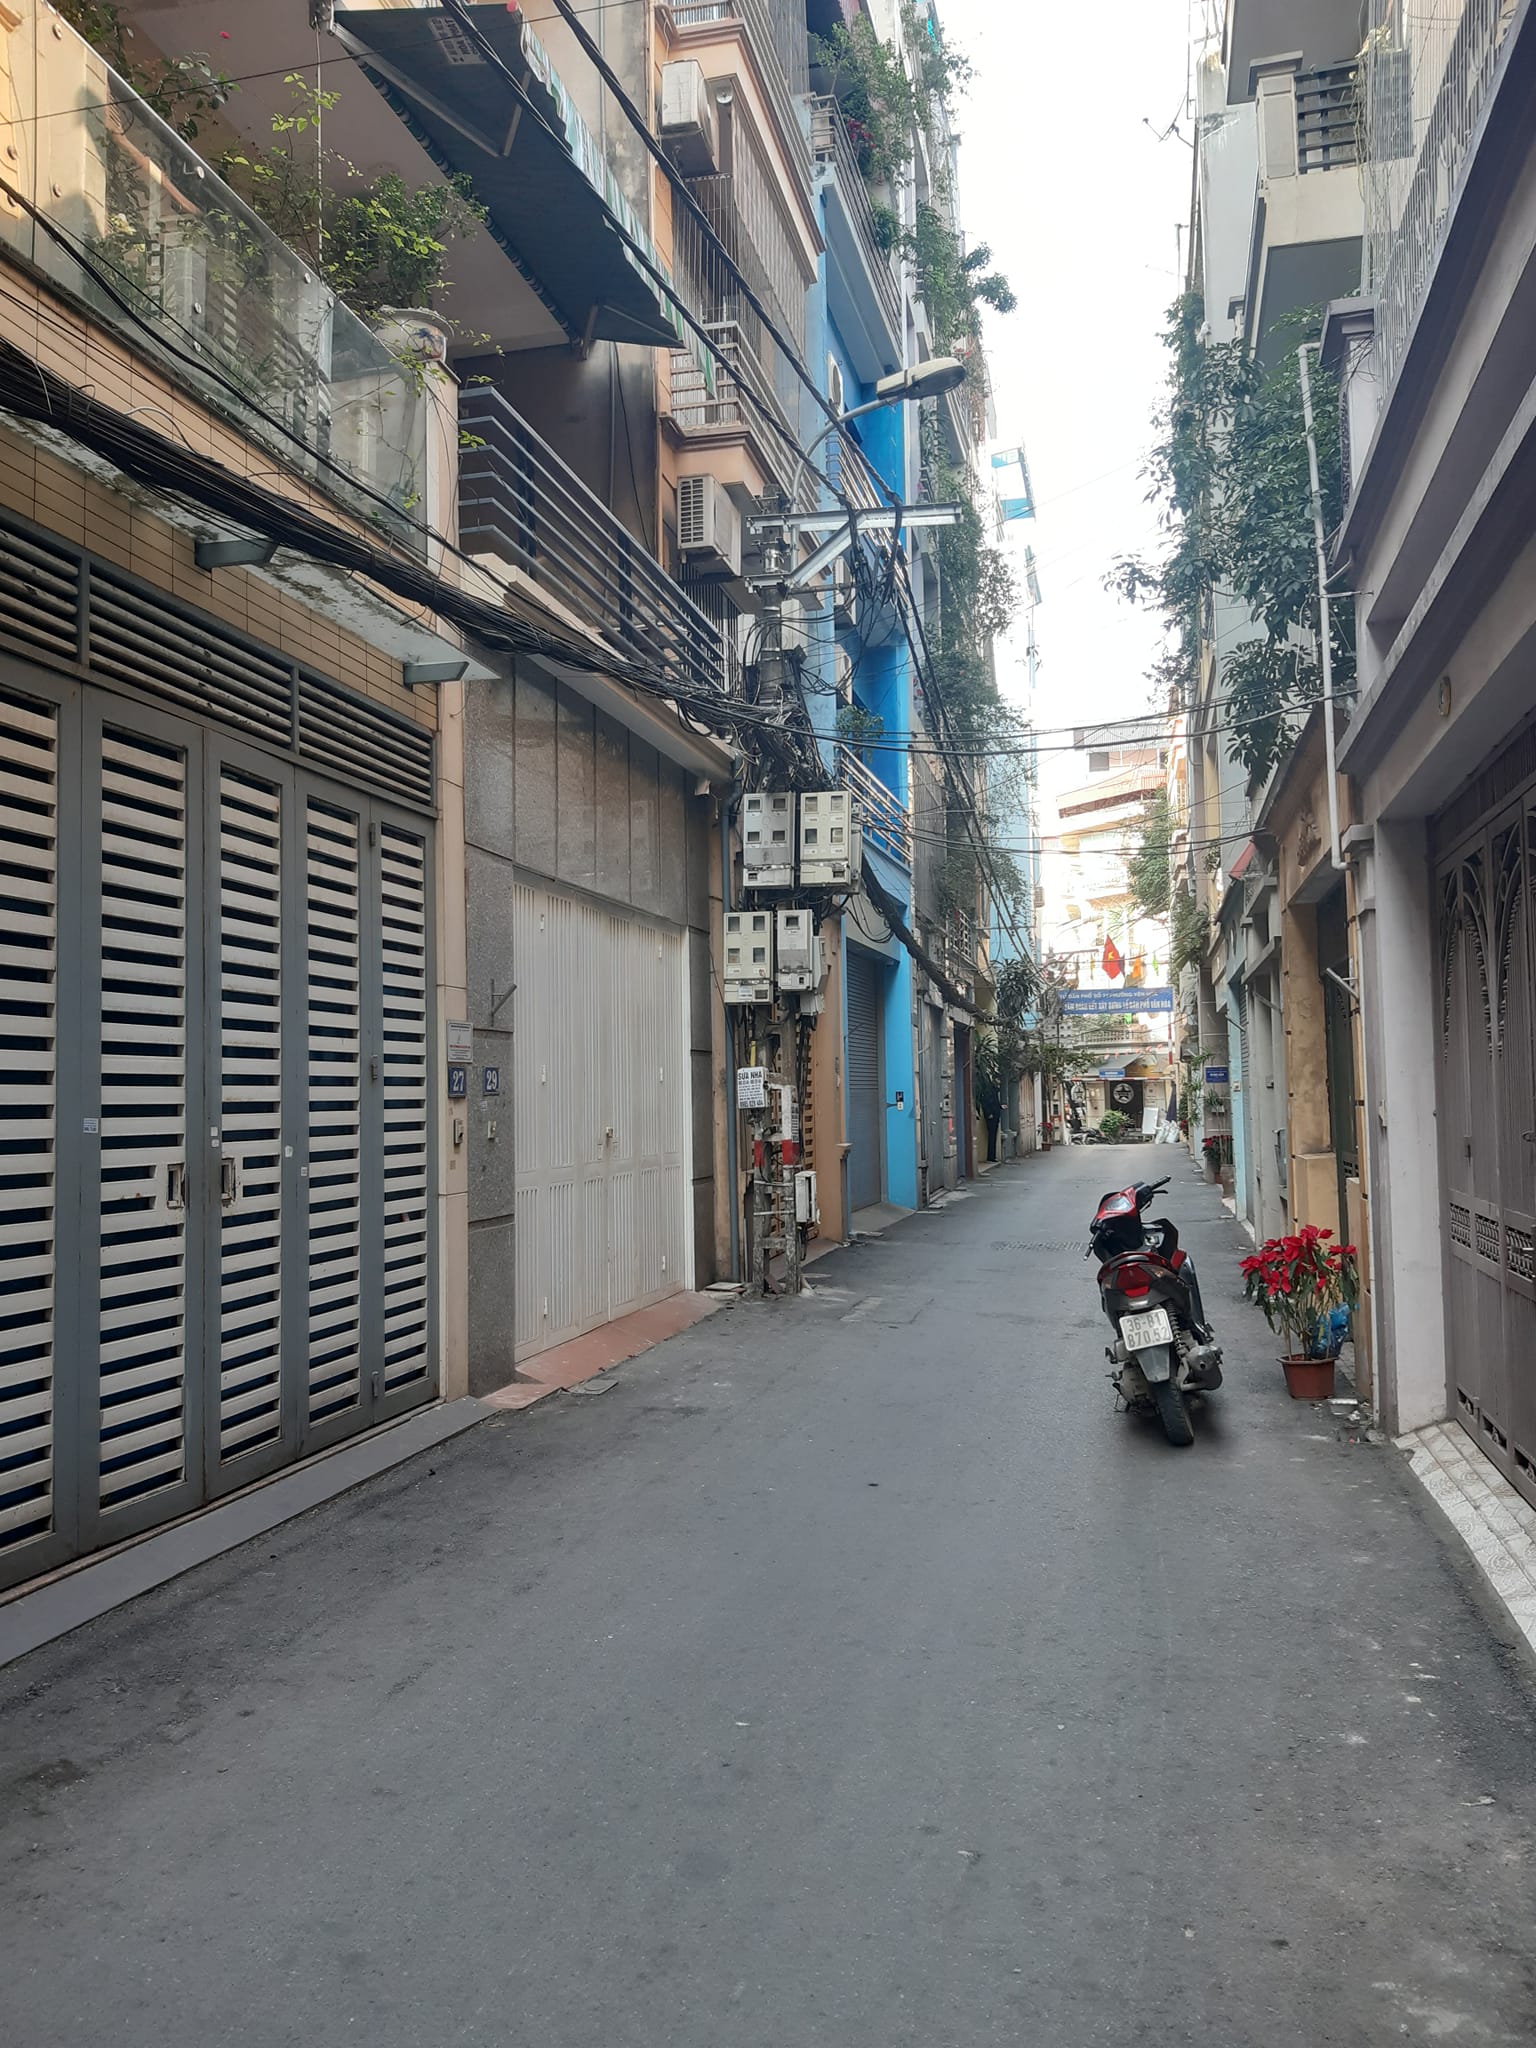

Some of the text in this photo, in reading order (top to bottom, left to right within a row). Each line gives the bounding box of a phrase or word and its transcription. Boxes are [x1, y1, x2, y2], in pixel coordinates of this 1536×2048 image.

[1080, 991, 1092, 999] PHỐ
[453, 1070, 464, 1091] 27
[486, 1070, 497, 1090] 29
[1126, 1312, 1162, 1332] 36-B1
[1127, 1326, 1171, 1348] 870.52
